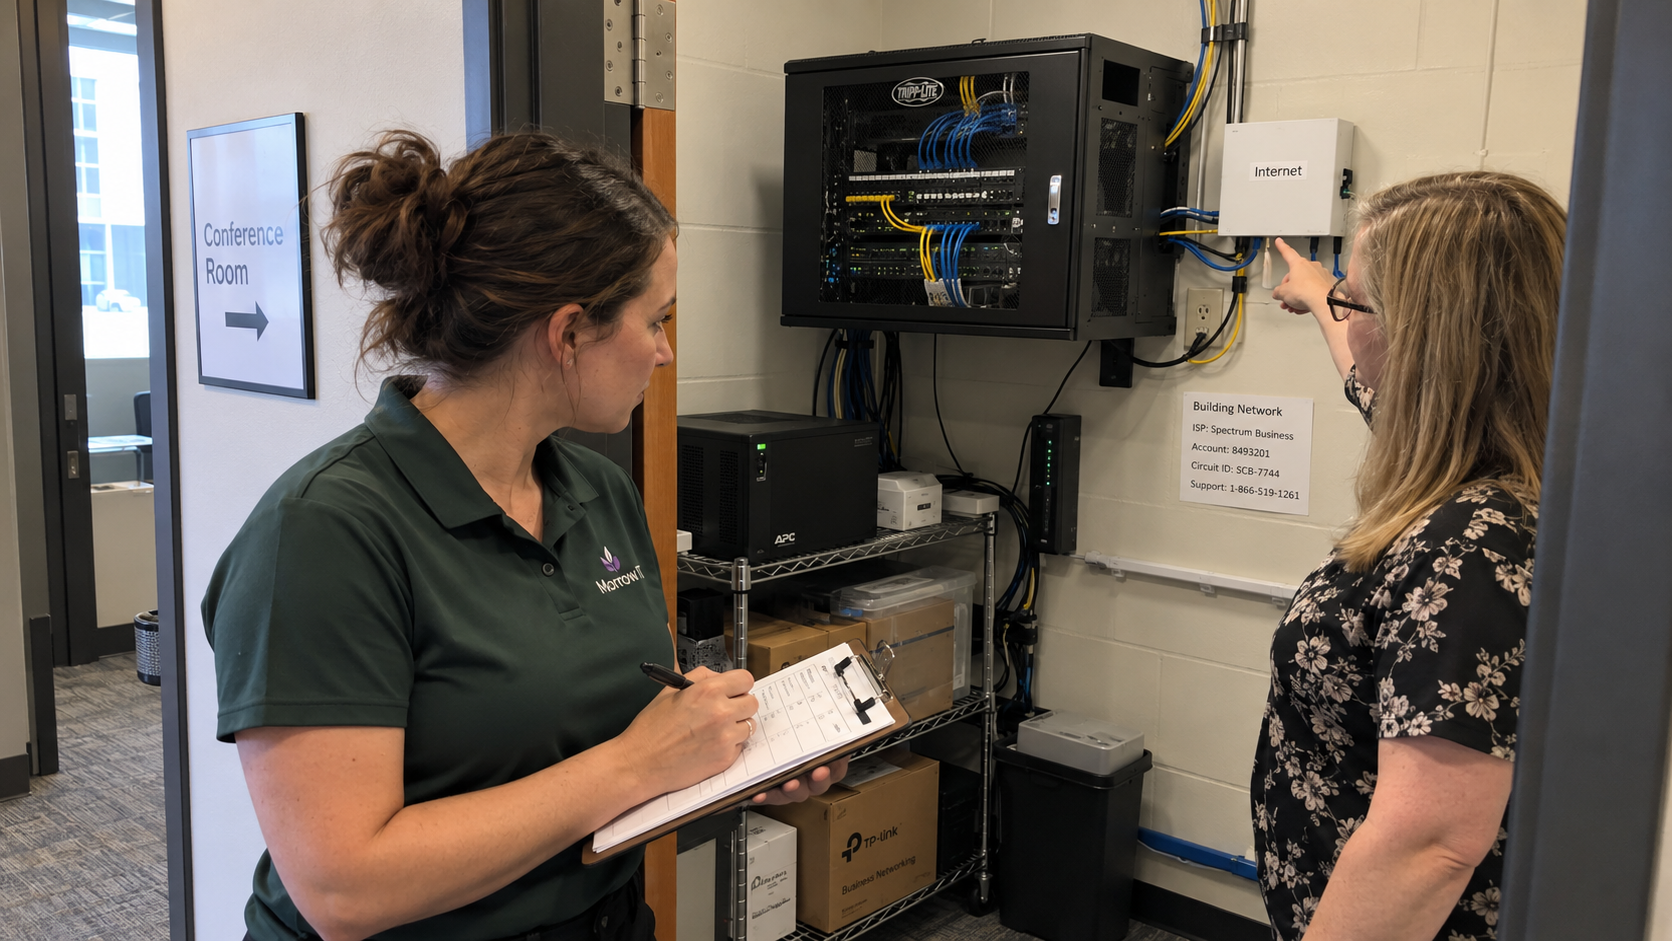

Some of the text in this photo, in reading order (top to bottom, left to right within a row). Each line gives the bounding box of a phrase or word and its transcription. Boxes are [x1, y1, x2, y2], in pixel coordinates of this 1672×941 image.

[1255, 166, 1302, 177] Internet
[204, 221, 284, 247] Conference
[206, 257, 249, 285] Room
[1193, 401, 1283, 416] Building Network
[1192, 423, 1294, 441] ISP: Spectrum Business
[1191, 443, 1270, 458] Account: 8493201
[1191, 461, 1280, 478] Circuit ID: SCB-7744
[1190, 480, 1227, 492] Support:
[774, 532, 795, 545] APC
[595, 570, 639, 594] Morrow
[842, 856, 917, 895] Business Networking
